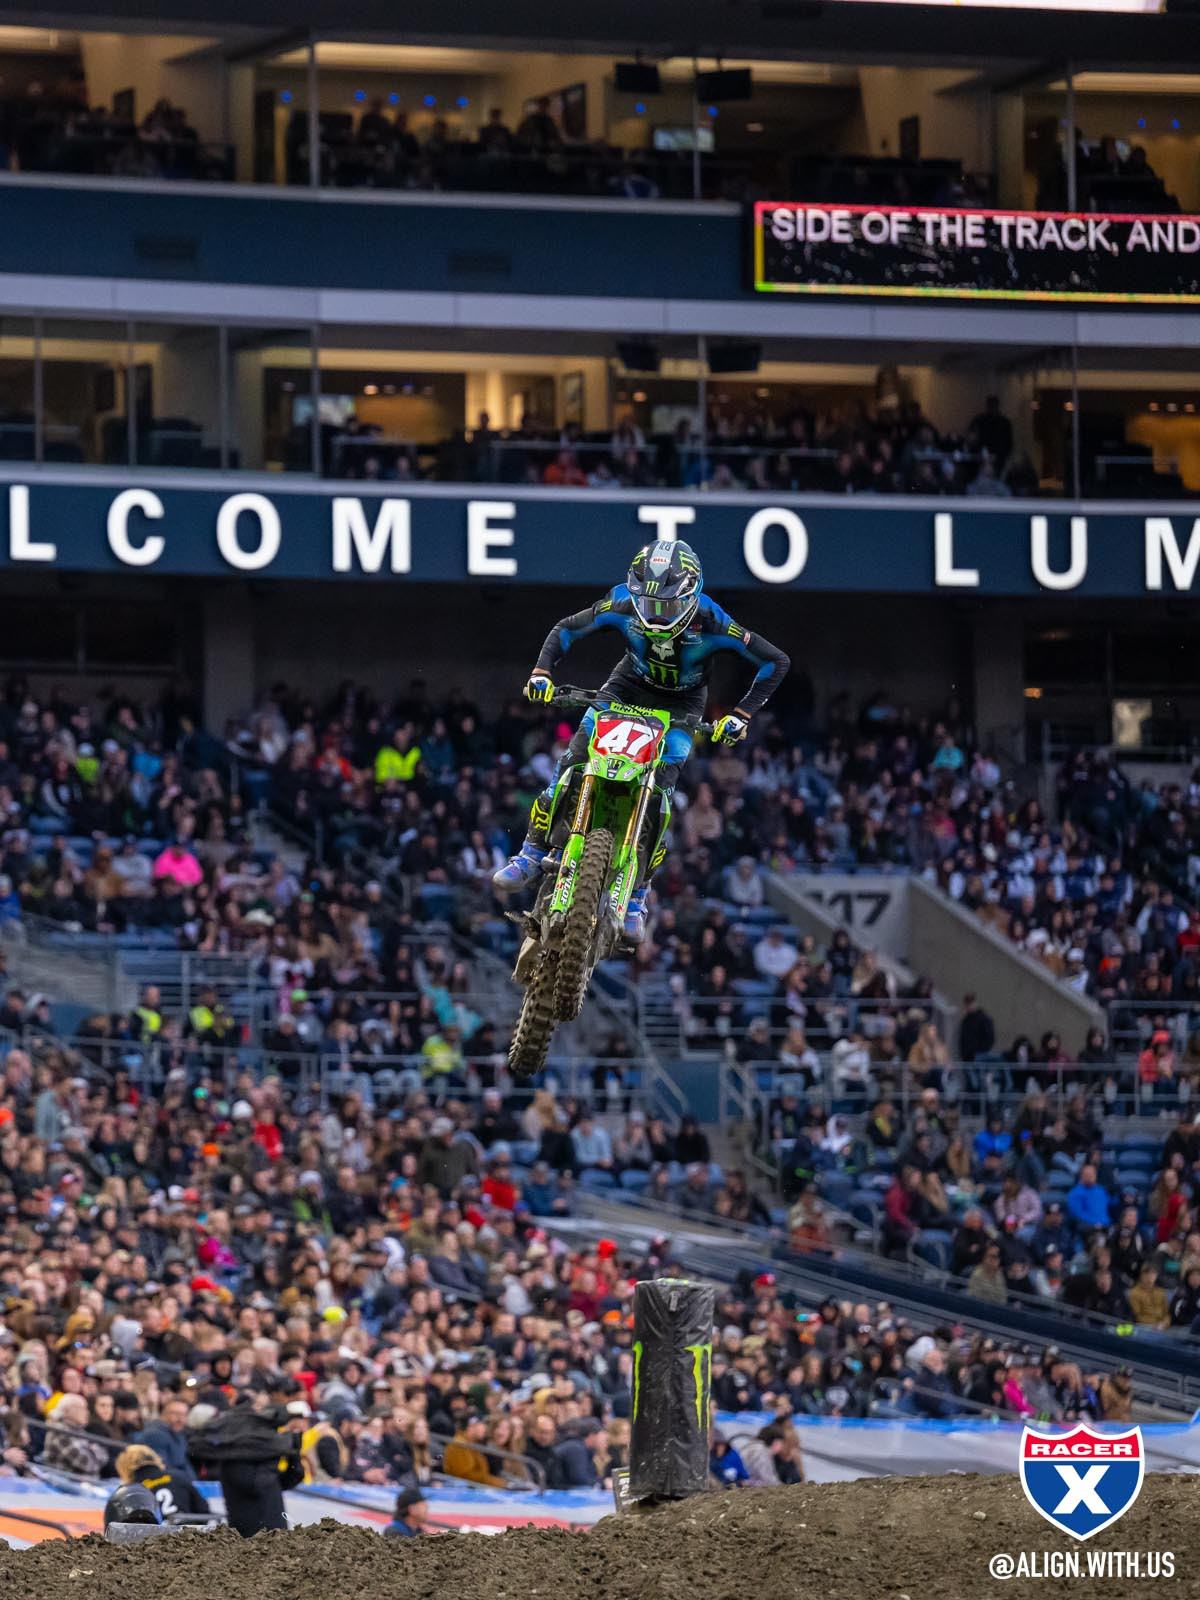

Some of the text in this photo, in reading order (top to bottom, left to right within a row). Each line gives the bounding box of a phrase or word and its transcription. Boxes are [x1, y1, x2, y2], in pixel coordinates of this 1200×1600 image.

[771, 207, 1200, 254] SIDE OF THE TRACK, AND
[638, 505, 808, 583] TO
[935, 513, 1200, 591] LUM
[597, 720, 660, 757] 47
[804, 889, 891, 926] 17
